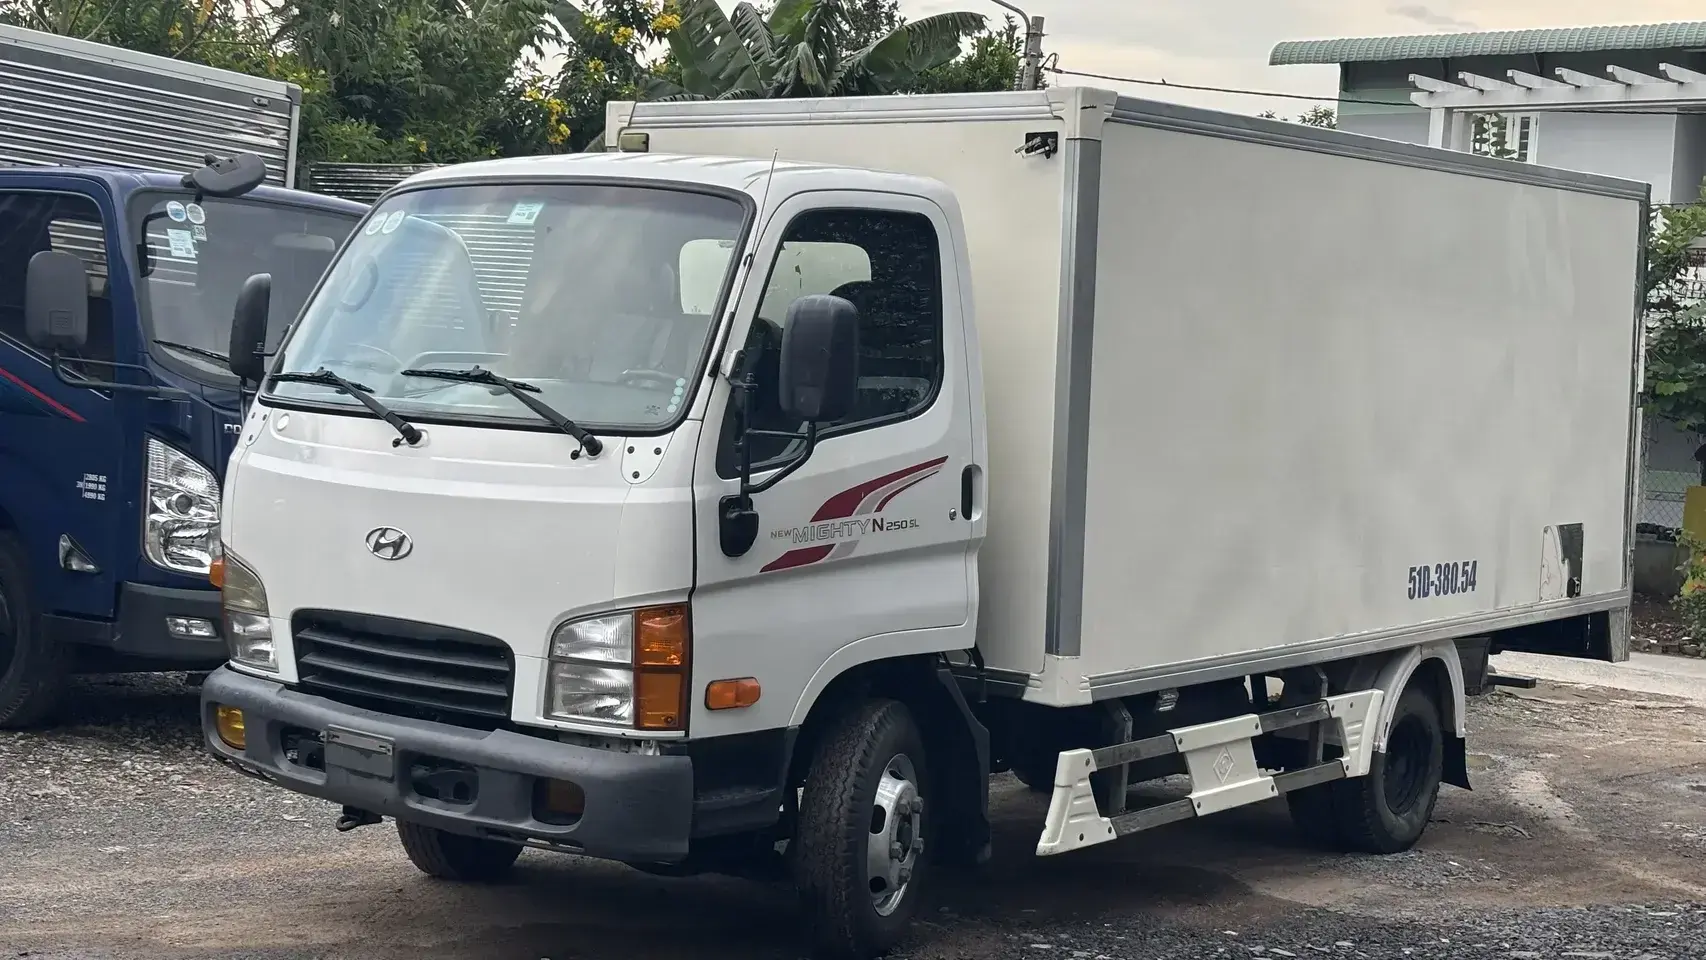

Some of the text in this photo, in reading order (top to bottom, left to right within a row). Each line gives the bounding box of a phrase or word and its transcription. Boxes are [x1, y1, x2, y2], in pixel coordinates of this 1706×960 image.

[99, 475, 107, 483] KG
[97, 493, 106, 501] KG
[770, 529, 792, 539] NEW
[792, 518, 871, 544] MIGHTY
[1408, 560, 1478, 600] 51D-380.54
